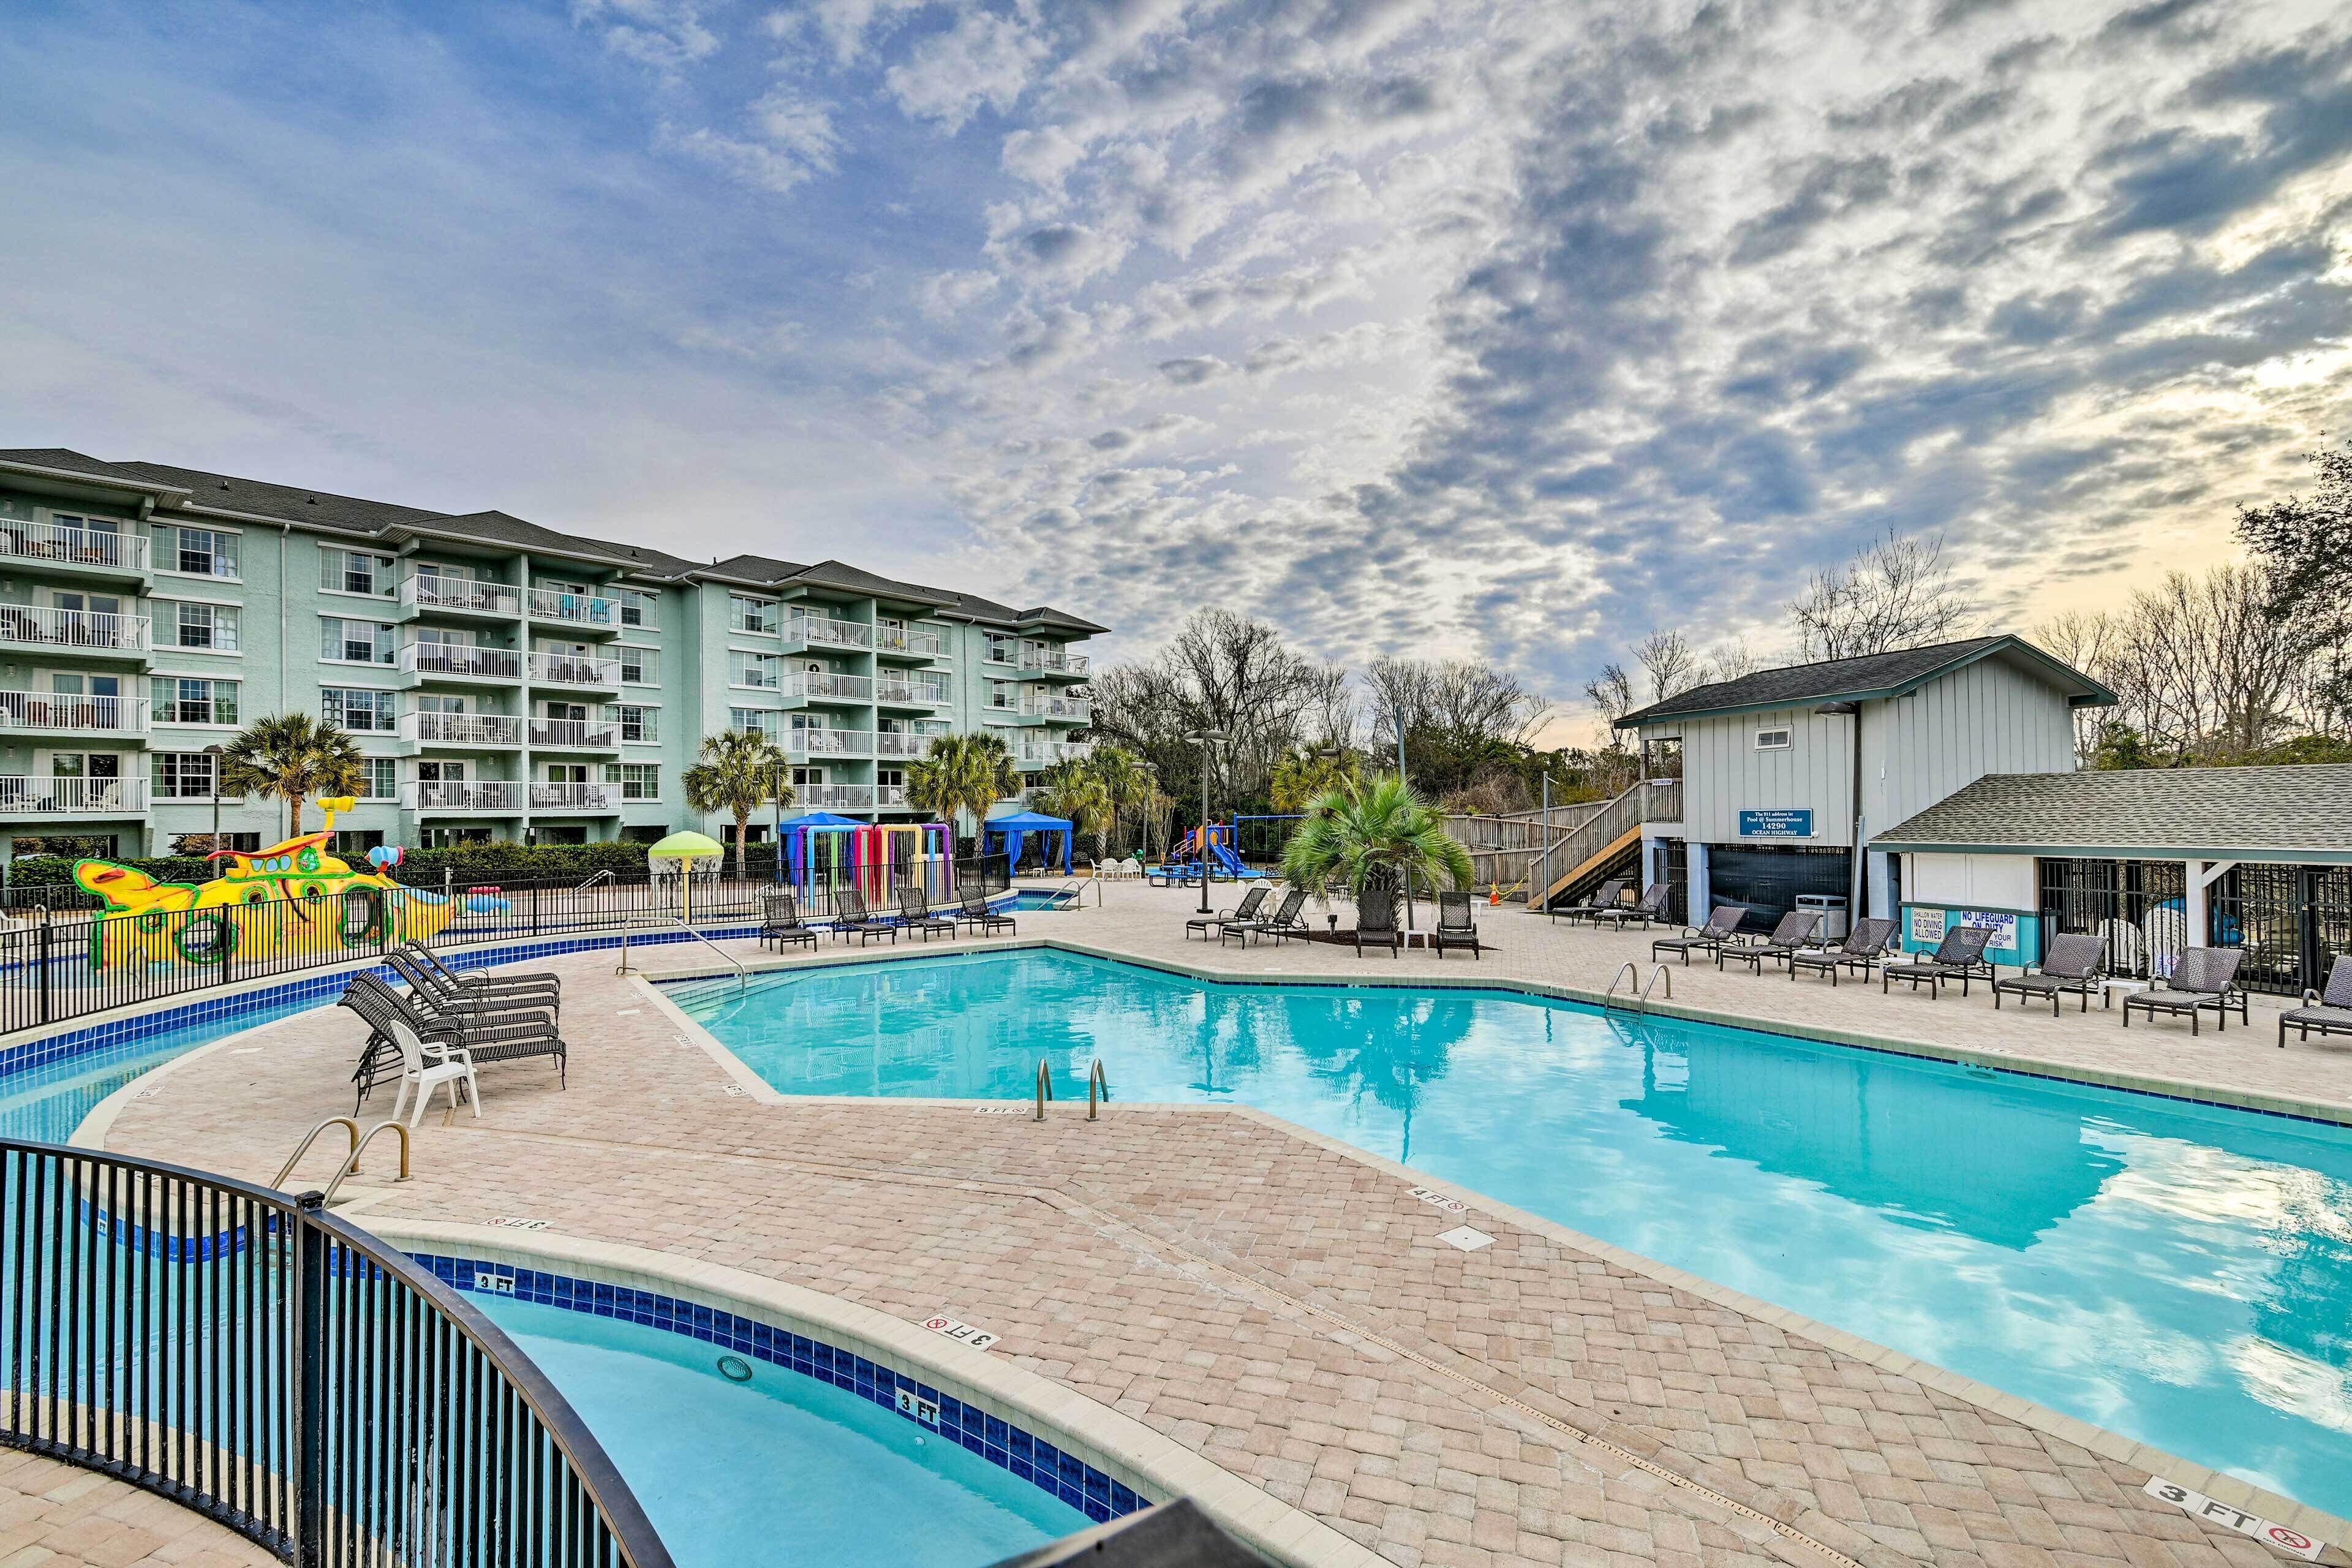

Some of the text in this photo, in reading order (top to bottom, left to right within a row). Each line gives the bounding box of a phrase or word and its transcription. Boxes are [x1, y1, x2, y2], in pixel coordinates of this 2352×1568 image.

[1913, 919, 1942, 929] NO DIVING
[1962, 911, 2013, 924] NO LIFEGUARD
[1915, 929, 1942, 940] ALLOWED
[1986, 923, 2003, 933] DUTY
[1425, 1194, 1449, 1204] FT
[481, 1276, 513, 1292] 3 FT
[944, 1325, 991, 1345] 3 FT
[902, 1394, 937, 1423] 3 FT
[2159, 1485, 2256, 1528] 3 FT
